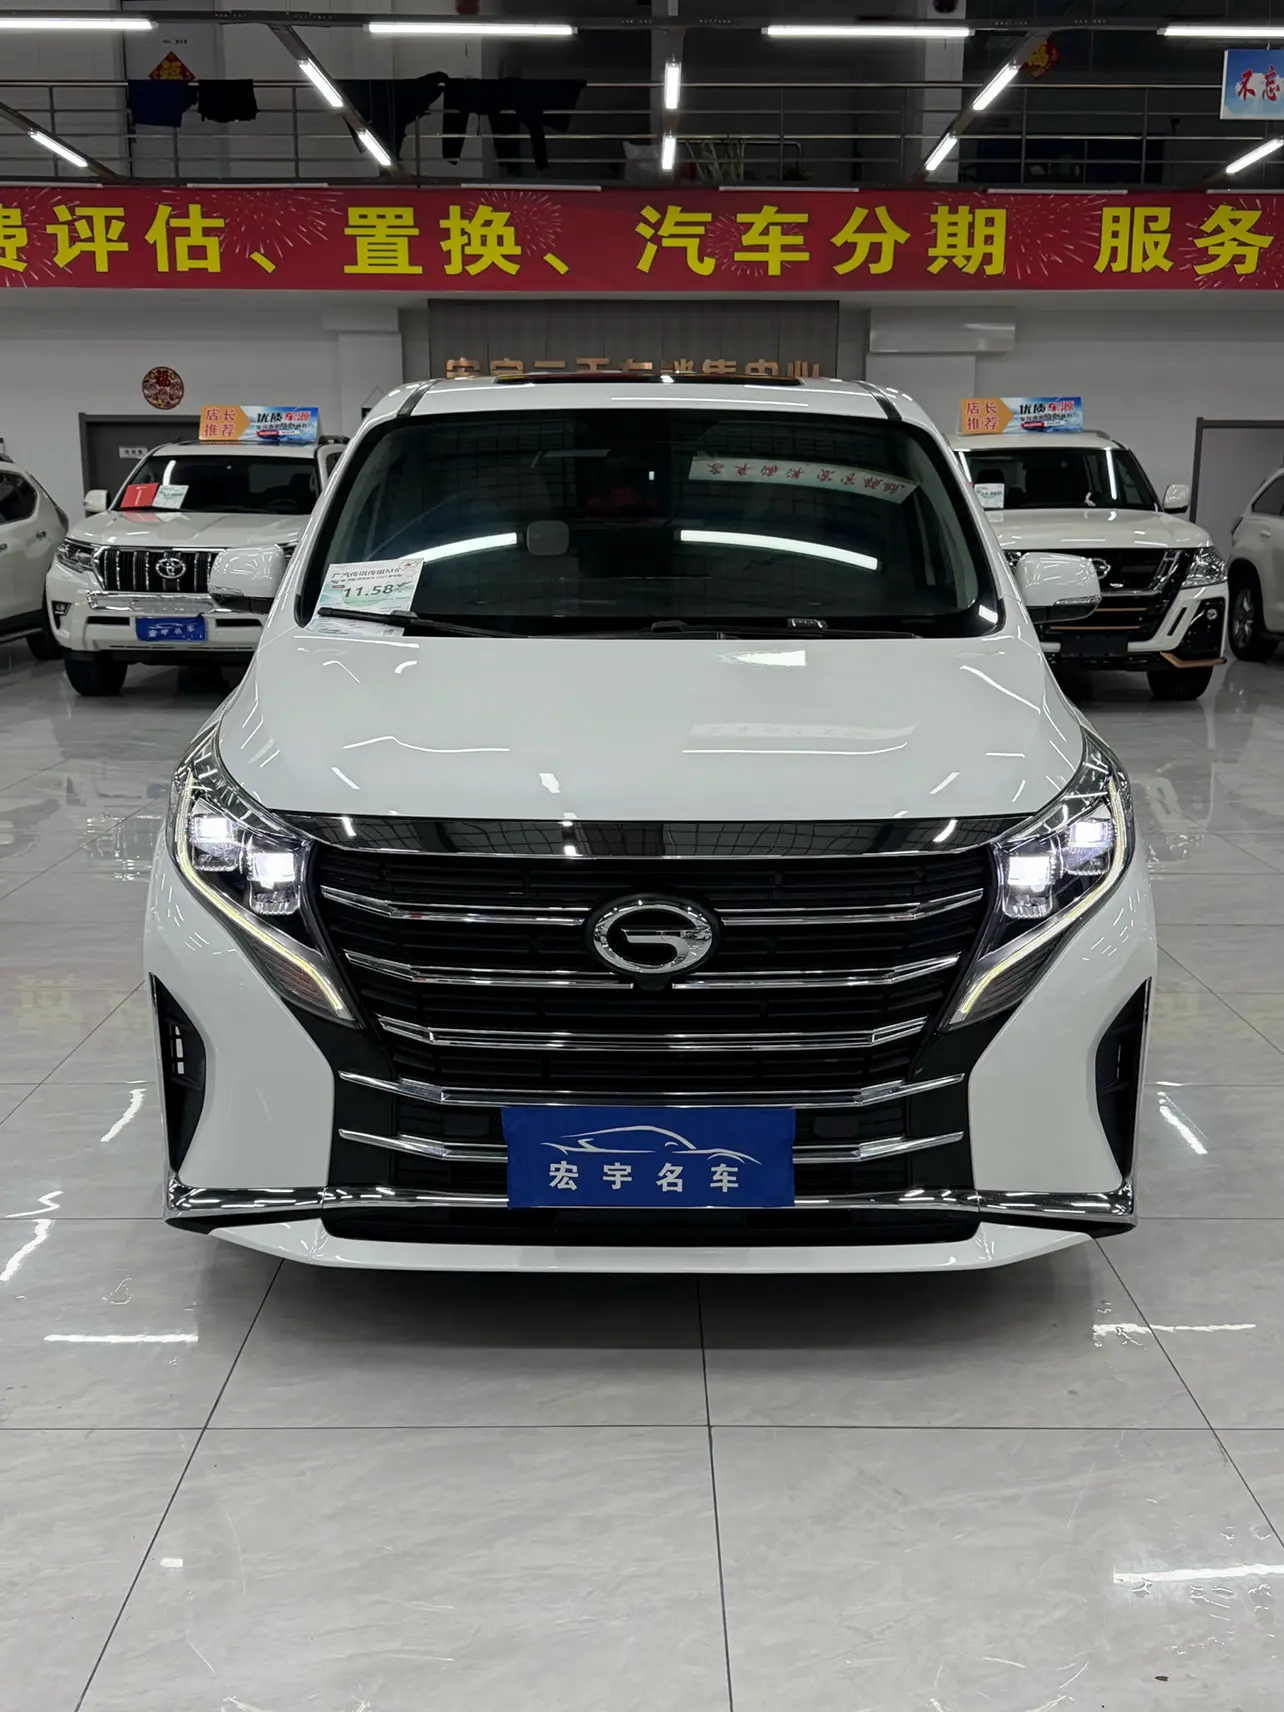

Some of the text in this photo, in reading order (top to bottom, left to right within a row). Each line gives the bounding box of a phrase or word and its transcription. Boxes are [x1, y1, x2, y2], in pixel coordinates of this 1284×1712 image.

[1237, 64, 1281, 101] 不忘
[1093, 204, 1275, 277] 服务
[205, 408, 236, 421] 店长
[966, 402, 998, 415] 店长
[1020, 401, 1075, 415] 优质车源
[257, 411, 312, 423] 优质车源
[967, 417, 998, 430] 推荐
[204, 424, 236, 437] 推荐
[549, 1161, 739, 1192] 宏宇名车
